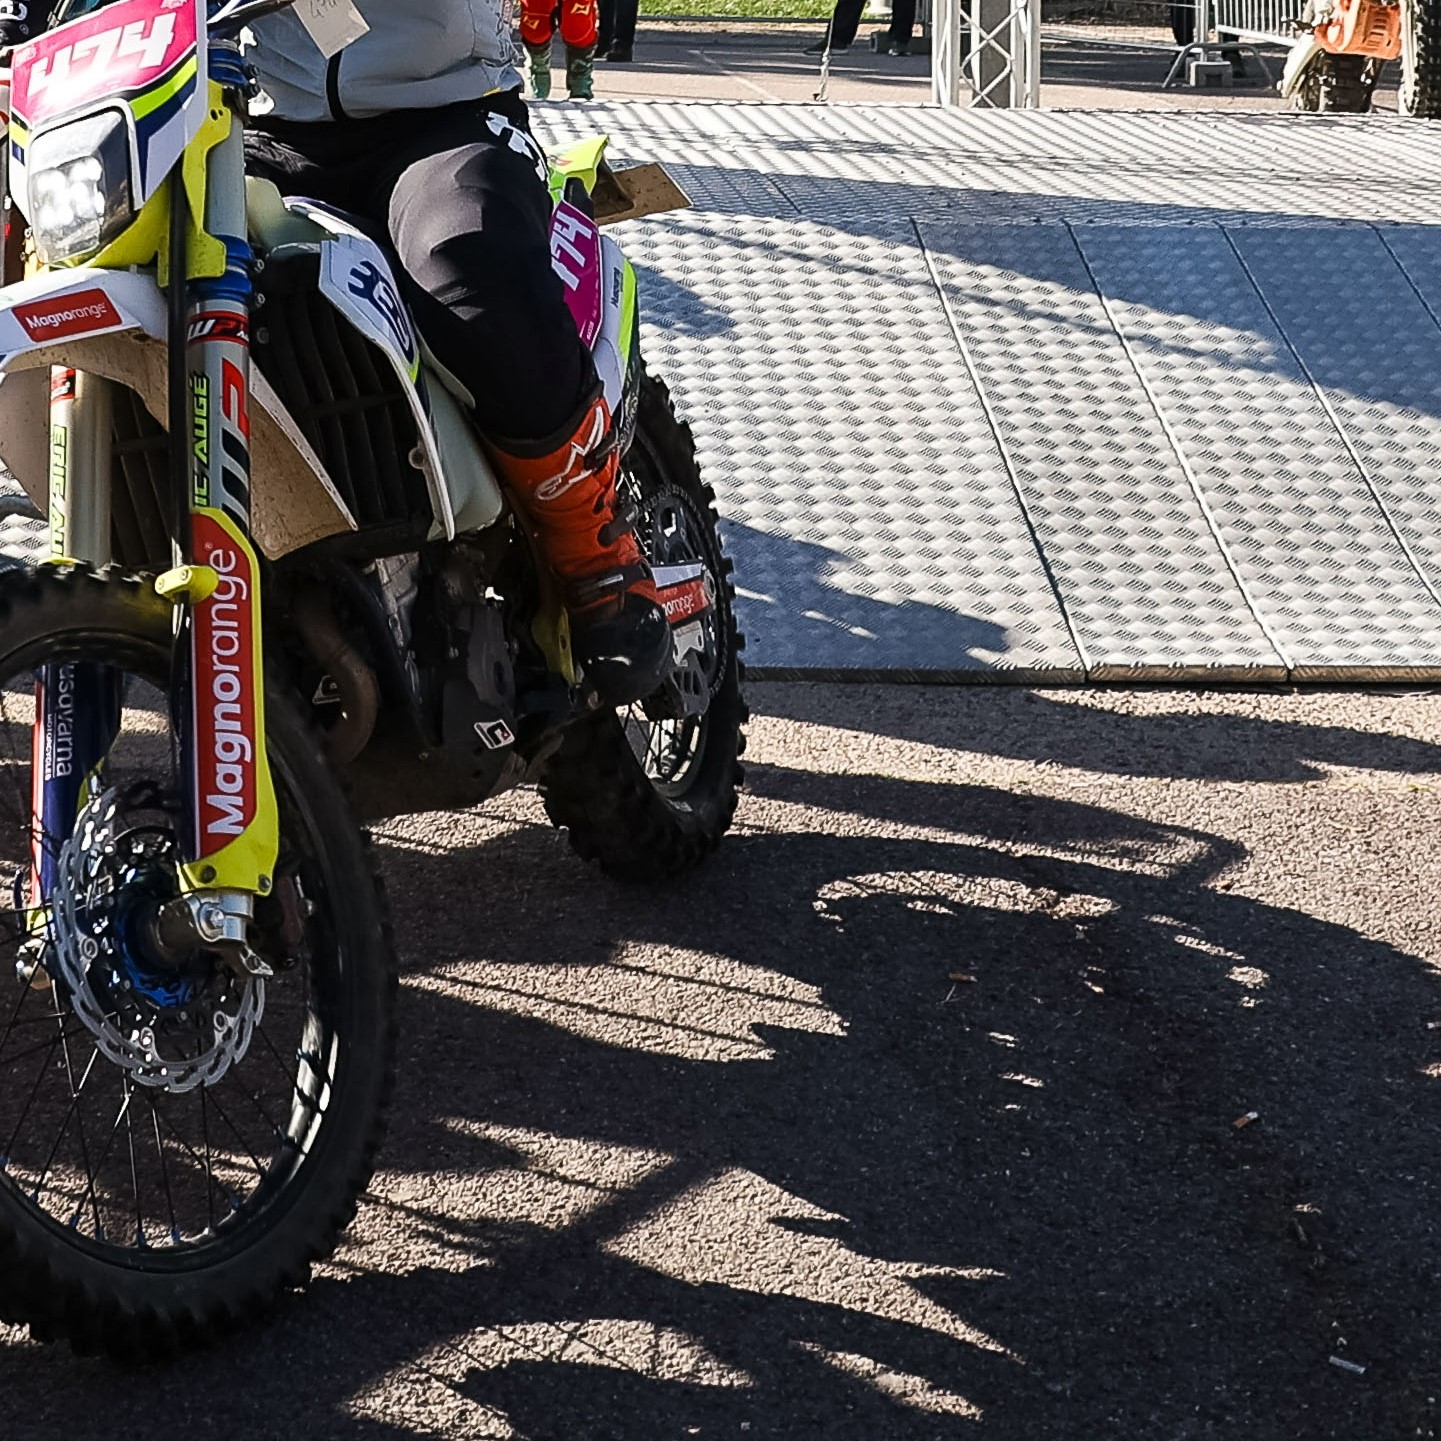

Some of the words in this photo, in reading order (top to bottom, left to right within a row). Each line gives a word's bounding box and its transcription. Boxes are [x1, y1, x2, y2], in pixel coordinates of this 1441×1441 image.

[27, 12, 176, 100] 474
[24, 301, 107, 330] Magnorange
[55, 660, 76, 777] usqvarna
[206, 549, 252, 836] Magnorange
